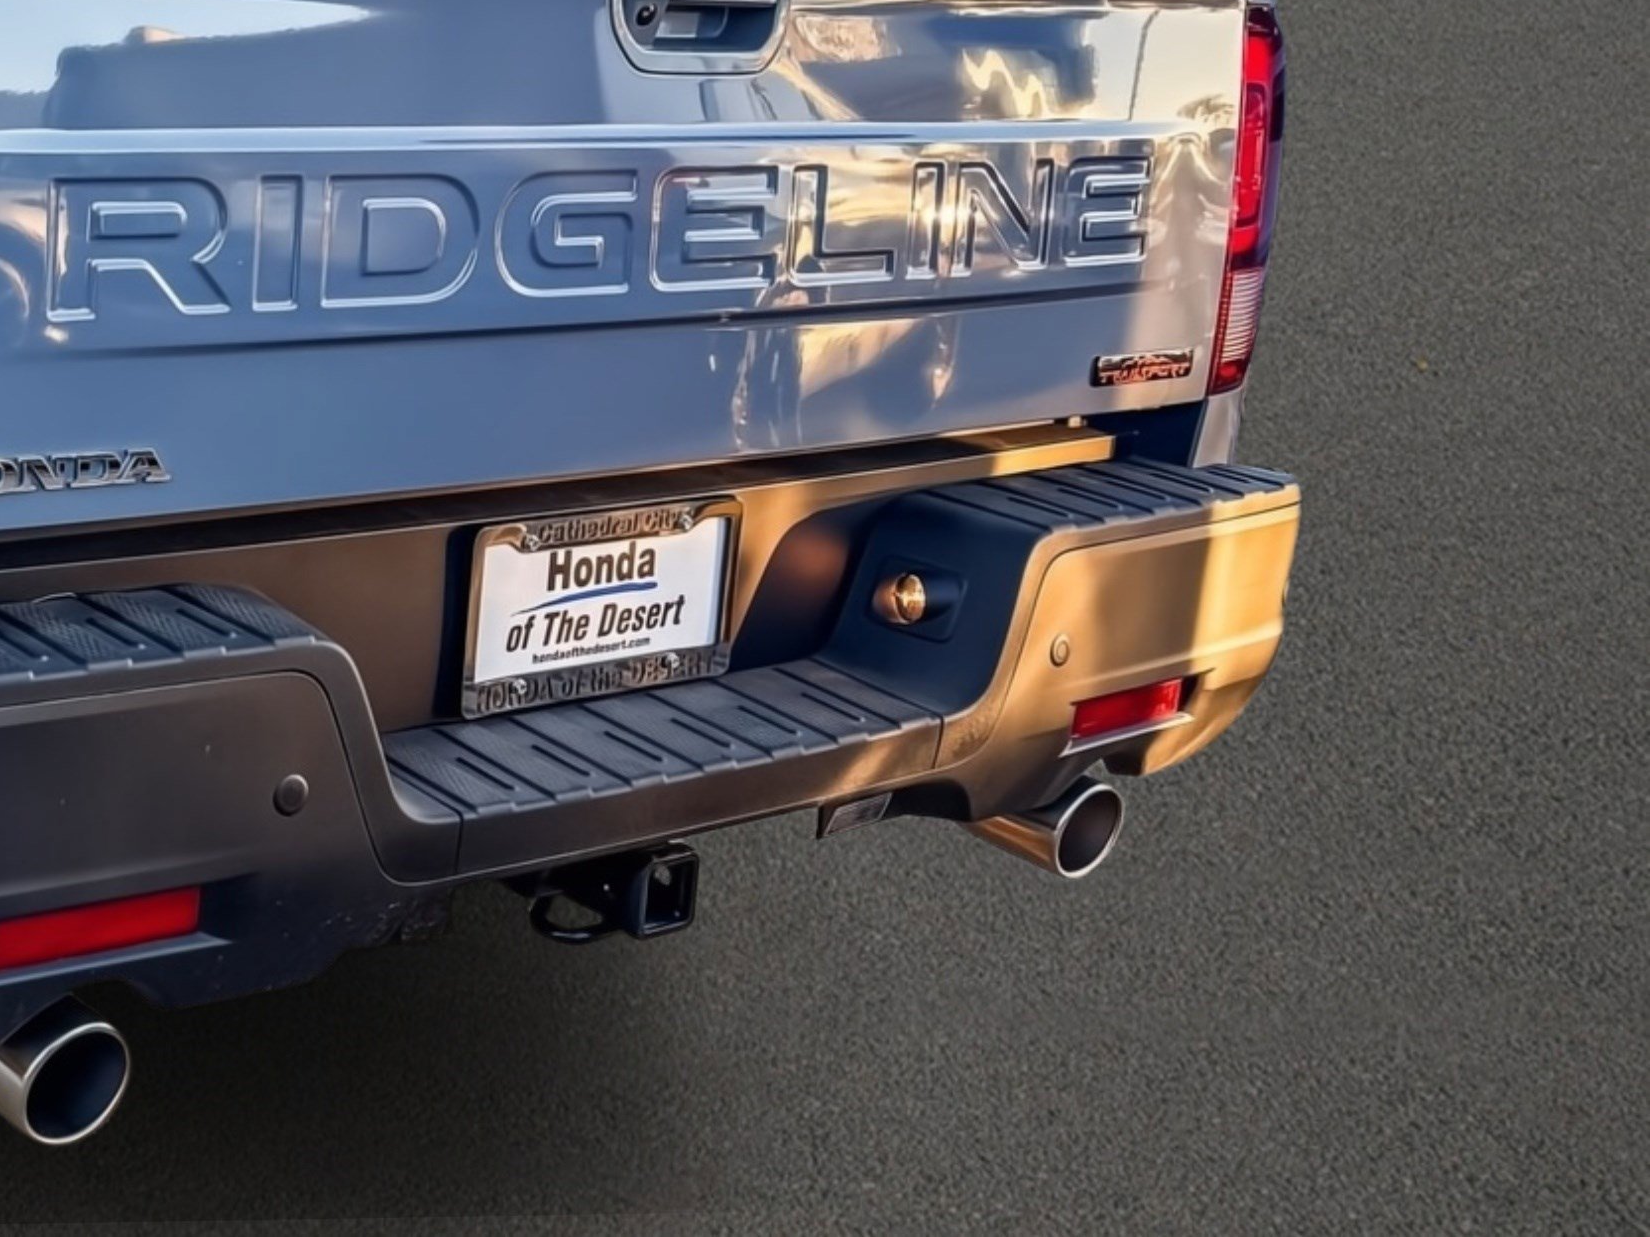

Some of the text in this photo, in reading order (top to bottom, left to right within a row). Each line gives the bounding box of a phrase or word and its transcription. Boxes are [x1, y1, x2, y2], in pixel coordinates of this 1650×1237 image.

[43, 152, 1152, 323] RIDGELINE
[538, 513, 639, 543] Cathedral
[545, 541, 657, 592] Honda
[505, 594, 686, 653] of The Desert
[531, 636, 652, 664] hondaofthedesert.com
